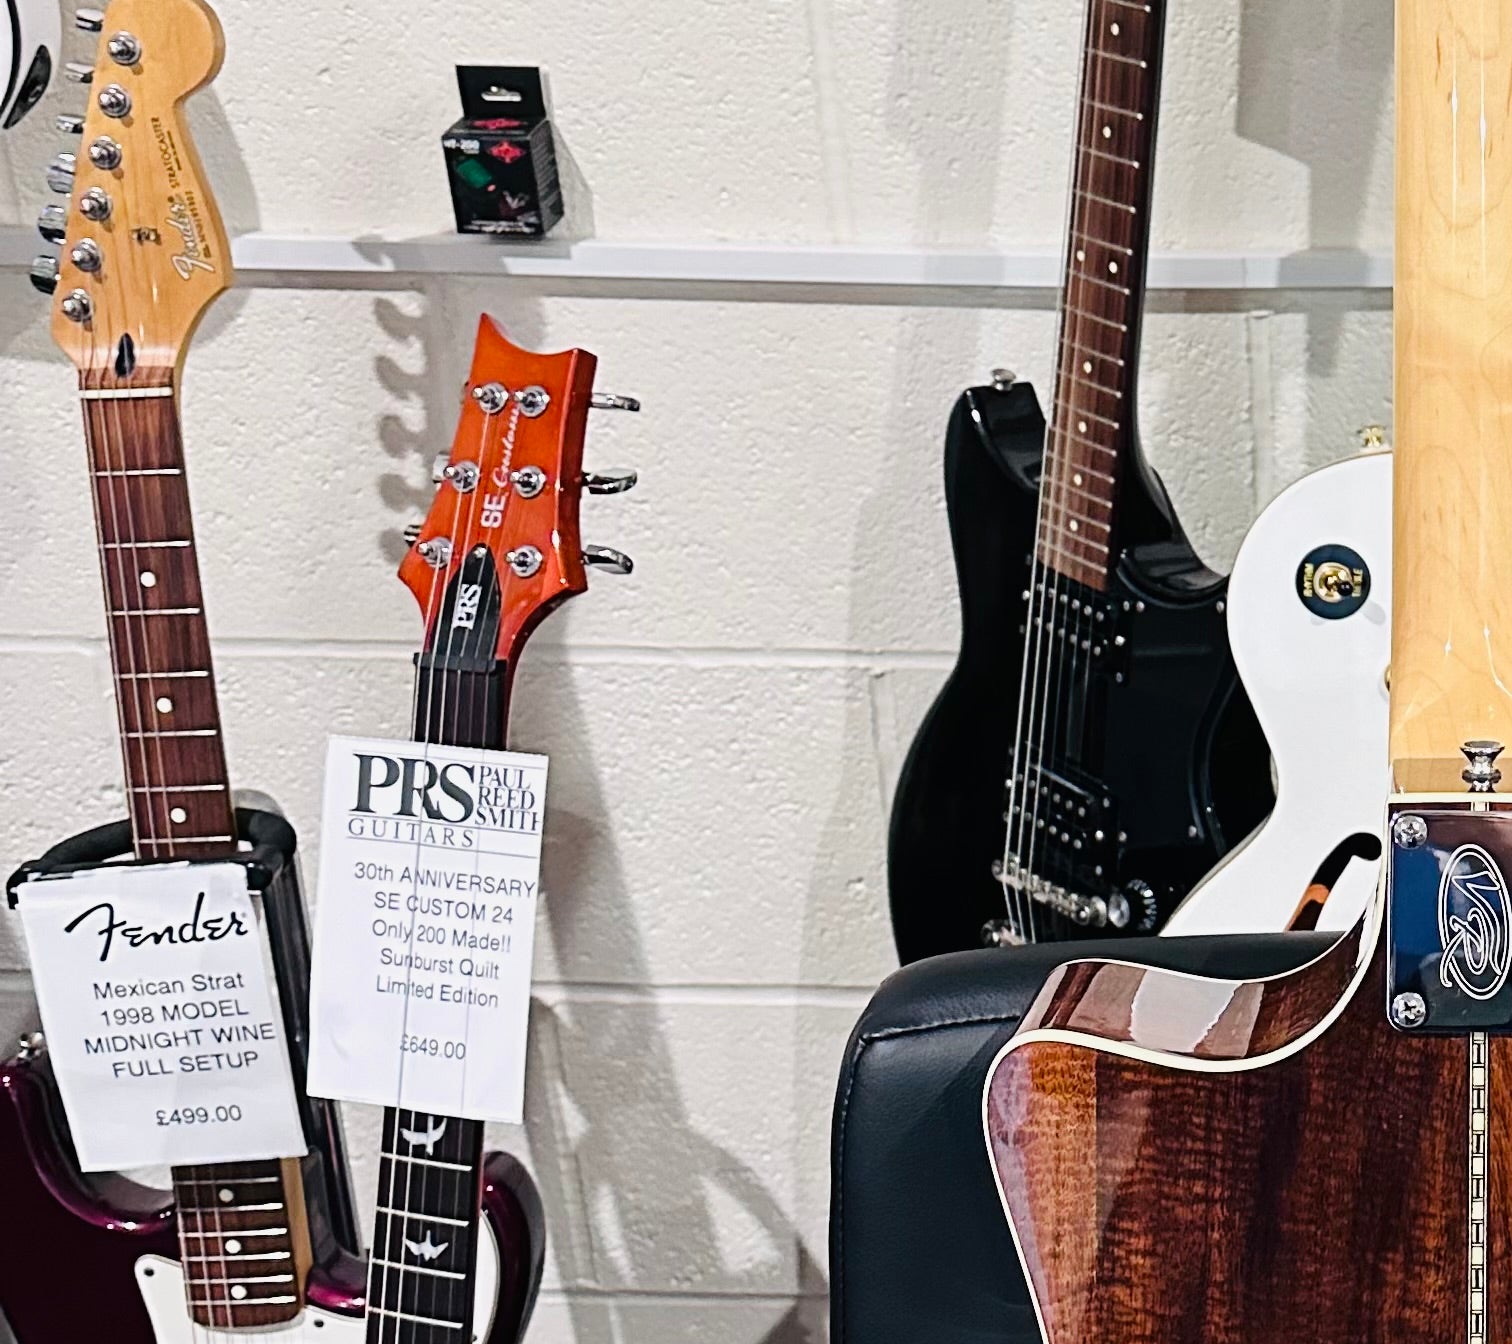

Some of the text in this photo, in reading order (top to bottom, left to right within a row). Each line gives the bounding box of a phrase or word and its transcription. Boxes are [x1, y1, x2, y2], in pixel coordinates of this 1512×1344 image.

[151, 116, 180, 188] STRATOCASTER
[481, 494, 505, 528] SE
[452, 584, 482, 630] PRS
[349, 753, 474, 823] PRS
[479, 765, 531, 789] PAUL
[478, 787, 535, 810] REED
[348, 817, 474, 848] GUITARS
[354, 862, 536, 898] 30th ANNIVERSARY
[374, 891, 514, 924] SE CUSTOM 24
[64, 892, 248, 962] Fender
[372, 919, 512, 953] Only 200 Made!!
[380, 948, 500, 980] Sunburst Quilt
[94, 973, 245, 999] Mexican Strat
[376, 975, 498, 1008] Limited Edition
[101, 999, 249, 1026] 1998 MODEL
[85, 1023, 276, 1055] MIDNIGHT WINE
[399, 1033, 466, 1060] £649.00
[113, 1051, 259, 1078] FULL SETUP
[156, 1105, 242, 1126] £499.00
